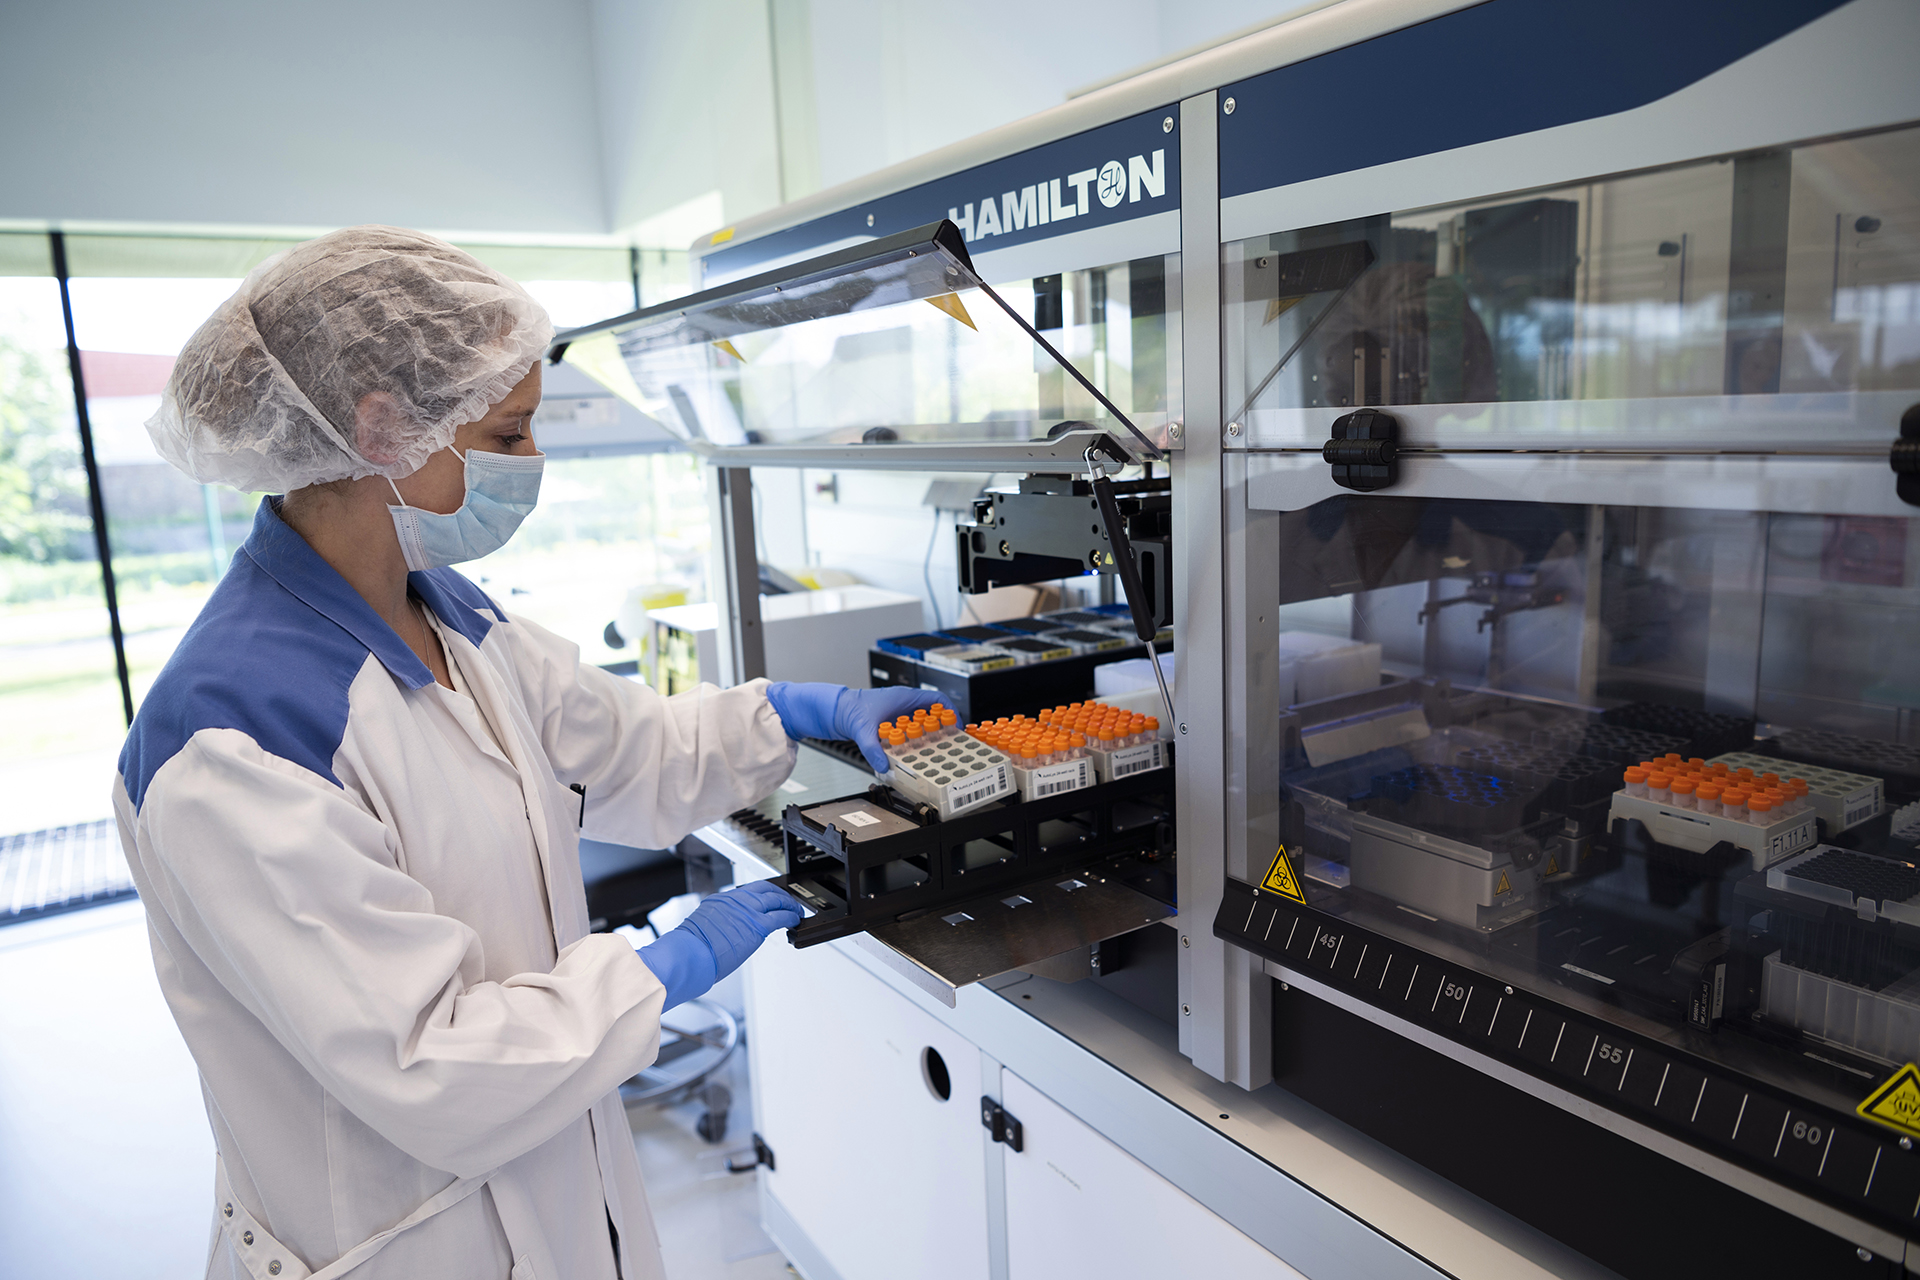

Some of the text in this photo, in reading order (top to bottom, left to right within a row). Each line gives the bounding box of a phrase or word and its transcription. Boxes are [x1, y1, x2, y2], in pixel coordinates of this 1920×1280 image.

[948, 148, 1166, 243] HAMILTON
[1319, 933, 1337, 949] 45
[1445, 982, 1465, 1001] 50
[1599, 1043, 1623, 1064] 55
[1792, 1121, 1822, 1145] 60
